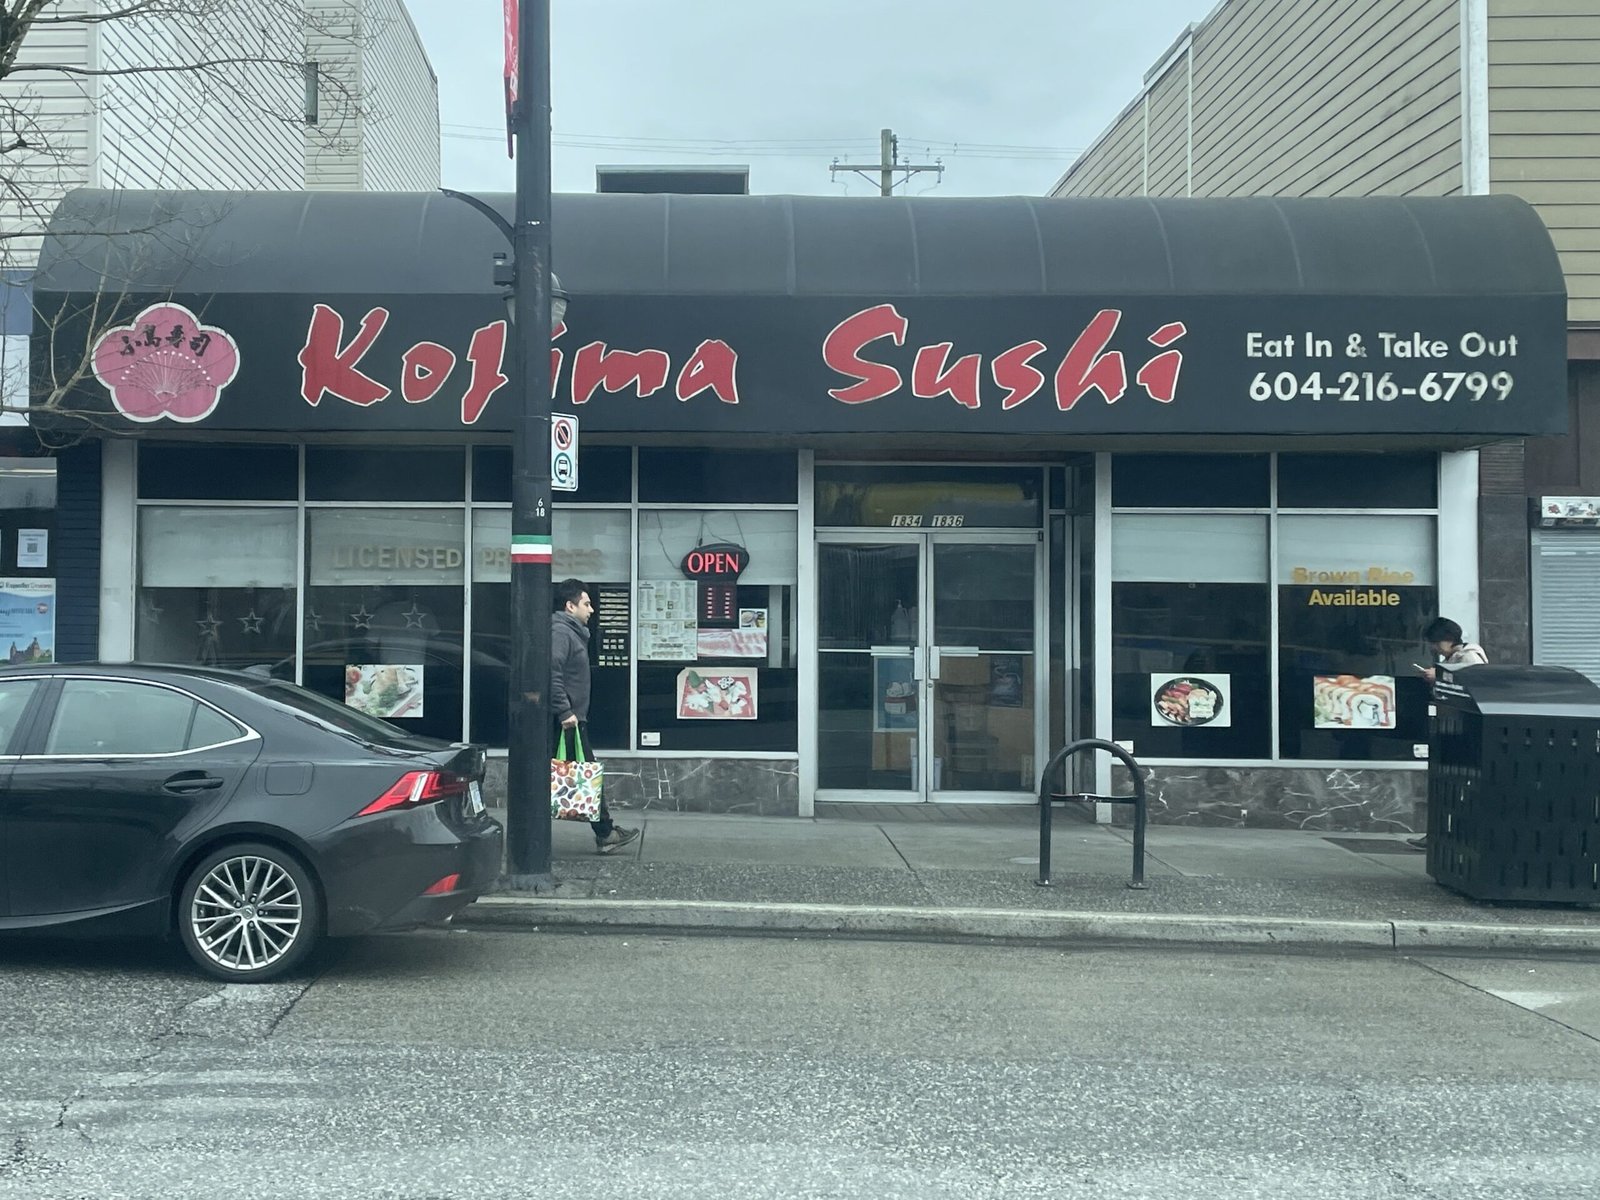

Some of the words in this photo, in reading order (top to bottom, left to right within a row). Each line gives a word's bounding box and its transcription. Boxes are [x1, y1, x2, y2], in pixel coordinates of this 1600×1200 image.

[1246, 332, 1295, 358] Eat
[1305, 332, 1333, 358] In
[1345, 333, 1367, 358] &
[1378, 332, 1449, 358] Take
[1459, 332, 1518, 358] Out
[823, 303, 1187, 411] Sushi
[1249, 371, 1514, 402] 604-216-6799
[536, 507, 545, 517] 18
[538, 498, 543, 507] 6
[893, 515, 922, 527] 1834
[933, 515, 963, 527] 1836
[334, 547, 463, 569] LICENSED
[480, 547, 605, 572] PRSES
[687, 552, 739, 574] OPEN
[1292, 567, 1361, 583] Brown
[1367, 567, 1414, 584] Rice
[1308, 589, 1401, 606] Available
